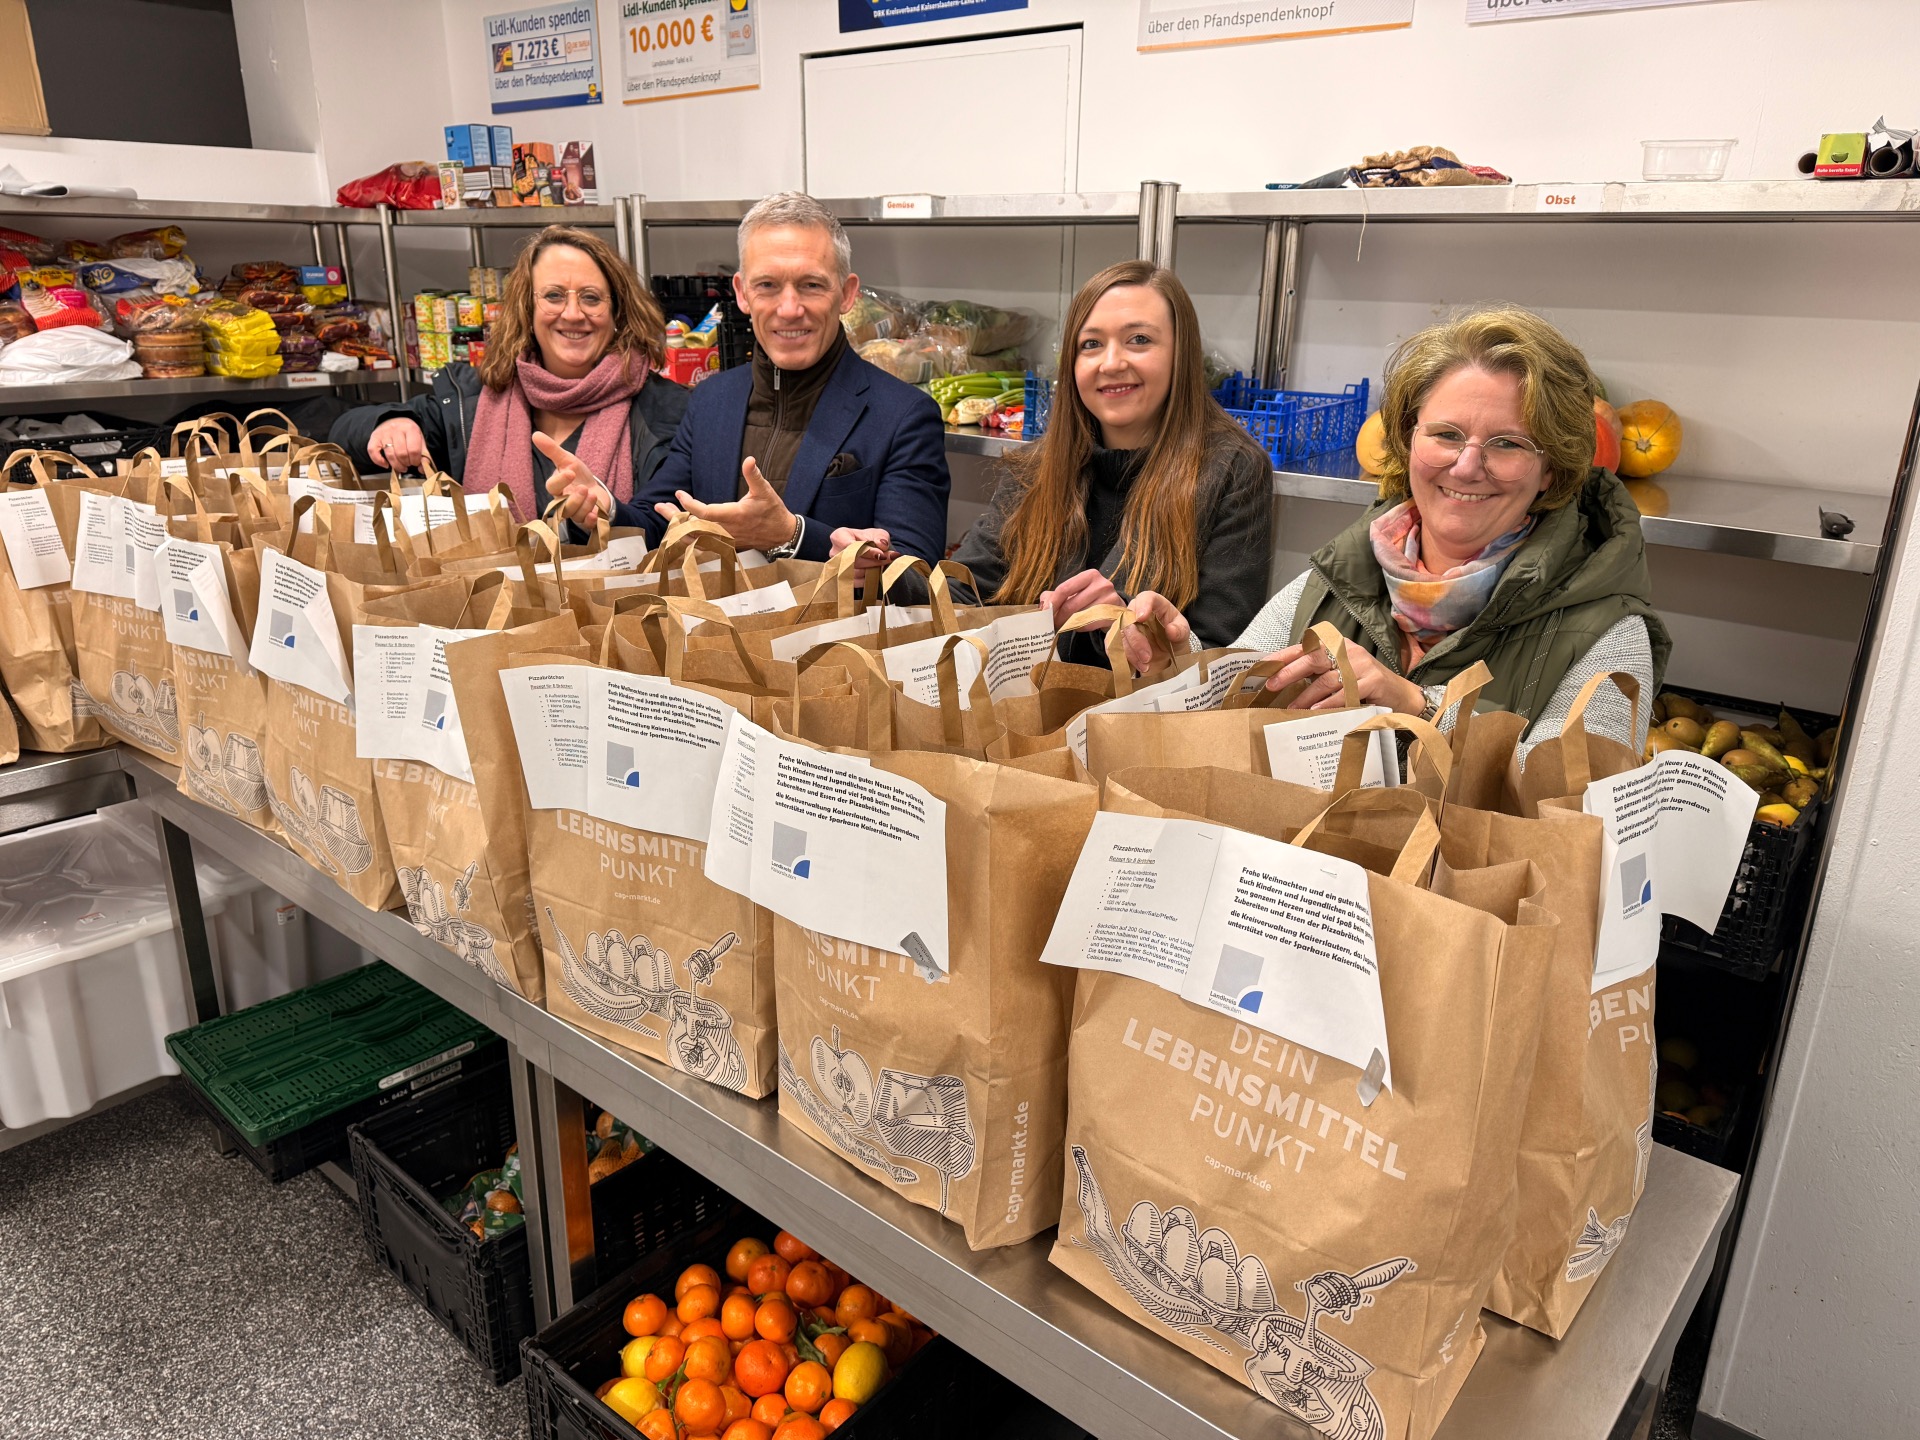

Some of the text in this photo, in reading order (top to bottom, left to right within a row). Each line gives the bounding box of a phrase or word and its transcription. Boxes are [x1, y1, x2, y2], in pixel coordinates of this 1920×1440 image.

[490, 7, 590, 38] Lidl-Kunden spenden
[623, 0, 678, 18] Lidl-Kunden
[874, 9, 885, 18] DRK
[1148, 1, 1334, 34] über den Pfandspendenknopf
[518, 39, 550, 61] 7.273
[551, 38, 559, 56] €
[630, 14, 714, 53] 10.000 €
[495, 66, 594, 89] über den Pfandspendenknopf
[627, 70, 721, 92] über den Pfandspendenknopf
[887, 201, 915, 210] Gemüse
[1545, 194, 1576, 205] Obst
[778, 762, 792, 771] Euch
[793, 766, 815, 778] Kindern
[829, 776, 867, 791] Jugendlichen
[877, 791, 891, 799] auch
[779, 754, 795, 763] Frohe
[796, 758, 834, 774] Weihnachten
[858, 777, 873, 785] gutes
[875, 781, 892, 790] Neues
[1681, 769, 1702, 780] Eurer
[1703, 776, 1726, 794] Familie
[1684, 761, 1701, 770] Jahr
[1703, 767, 1728, 786] wünscht
[776, 779, 806, 793] Zubereiten
[820, 792, 836, 801] Essen
[849, 799, 890, 816] Pizzabrötchen
[789, 775, 811, 785] ganzem
[812, 781, 833, 791] Herzen
[848, 790, 859, 798] viel
[860, 794, 874, 802] Spaß
[875, 798, 889, 807] beim
[1670, 796, 1710, 814] Jugendamt
[1676, 778, 1724, 801] gemeinsamen
[785, 794, 831, 813] Kreisverwaltung
[878, 820, 888, 828] das
[829, 816, 860, 828] Sparkasse
[861, 823, 902, 841] Kaiserslautern
[1113, 844, 1152, 853] Pizzabrötchen
[600, 852, 676, 888] PUNKT
[1242, 867, 1260, 878] Frohe
[1262, 873, 1307, 892] Weihnachten
[1309, 888, 1324, 897] und
[1338, 897, 1354, 906] gutes
[614, 891, 660, 905] cap-markt.de
[1239, 877, 1254, 886] Euch
[1256, 882, 1282, 895] Kindern
[1284, 892, 1299, 900] und
[1300, 895, 1346, 915] Jugendlichen
[1347, 910, 1355, 918] als
[1250, 891, 1276, 904] ganzem
[1278, 899, 1304, 912] Herzen
[1306, 910, 1320, 918] und
[1322, 914, 1335, 922] viel
[1336, 917, 1352, 928] Spaß
[1230, 910, 1240, 918] die
[1241, 912, 1298, 937] Kreisverwaltung
[1300, 931, 1352, 955] Kaiserslautern,
[1354, 950, 1362, 959] das
[1234, 896, 1268, 912] Zubereiten
[1270, 909, 1285, 917] und
[1286, 912, 1306, 924] Essen
[1307, 920, 1320, 928] der
[1321, 923, 1364, 946] Pizzabrötchen
[1228, 920, 1263, 936] unterstützt
[1265, 932, 1278, 941] von
[1280, 937, 1292, 946] der
[1293, 941, 1330, 958] Sparkasse
[807, 948, 880, 1001] PUNKT
[819, 995, 858, 1021] cap-markt.de
[1209, 990, 1237, 1006] Landkreis
[1230, 1023, 1319, 1084] DEIN
[1121, 1018, 1407, 1181] LEBENSMITTEL
[1189, 1094, 1316, 1174] PUNKT
[1005, 1100, 1029, 1224] cap-markt.de
[1204, 1153, 1273, 1193] cap-markt.de
